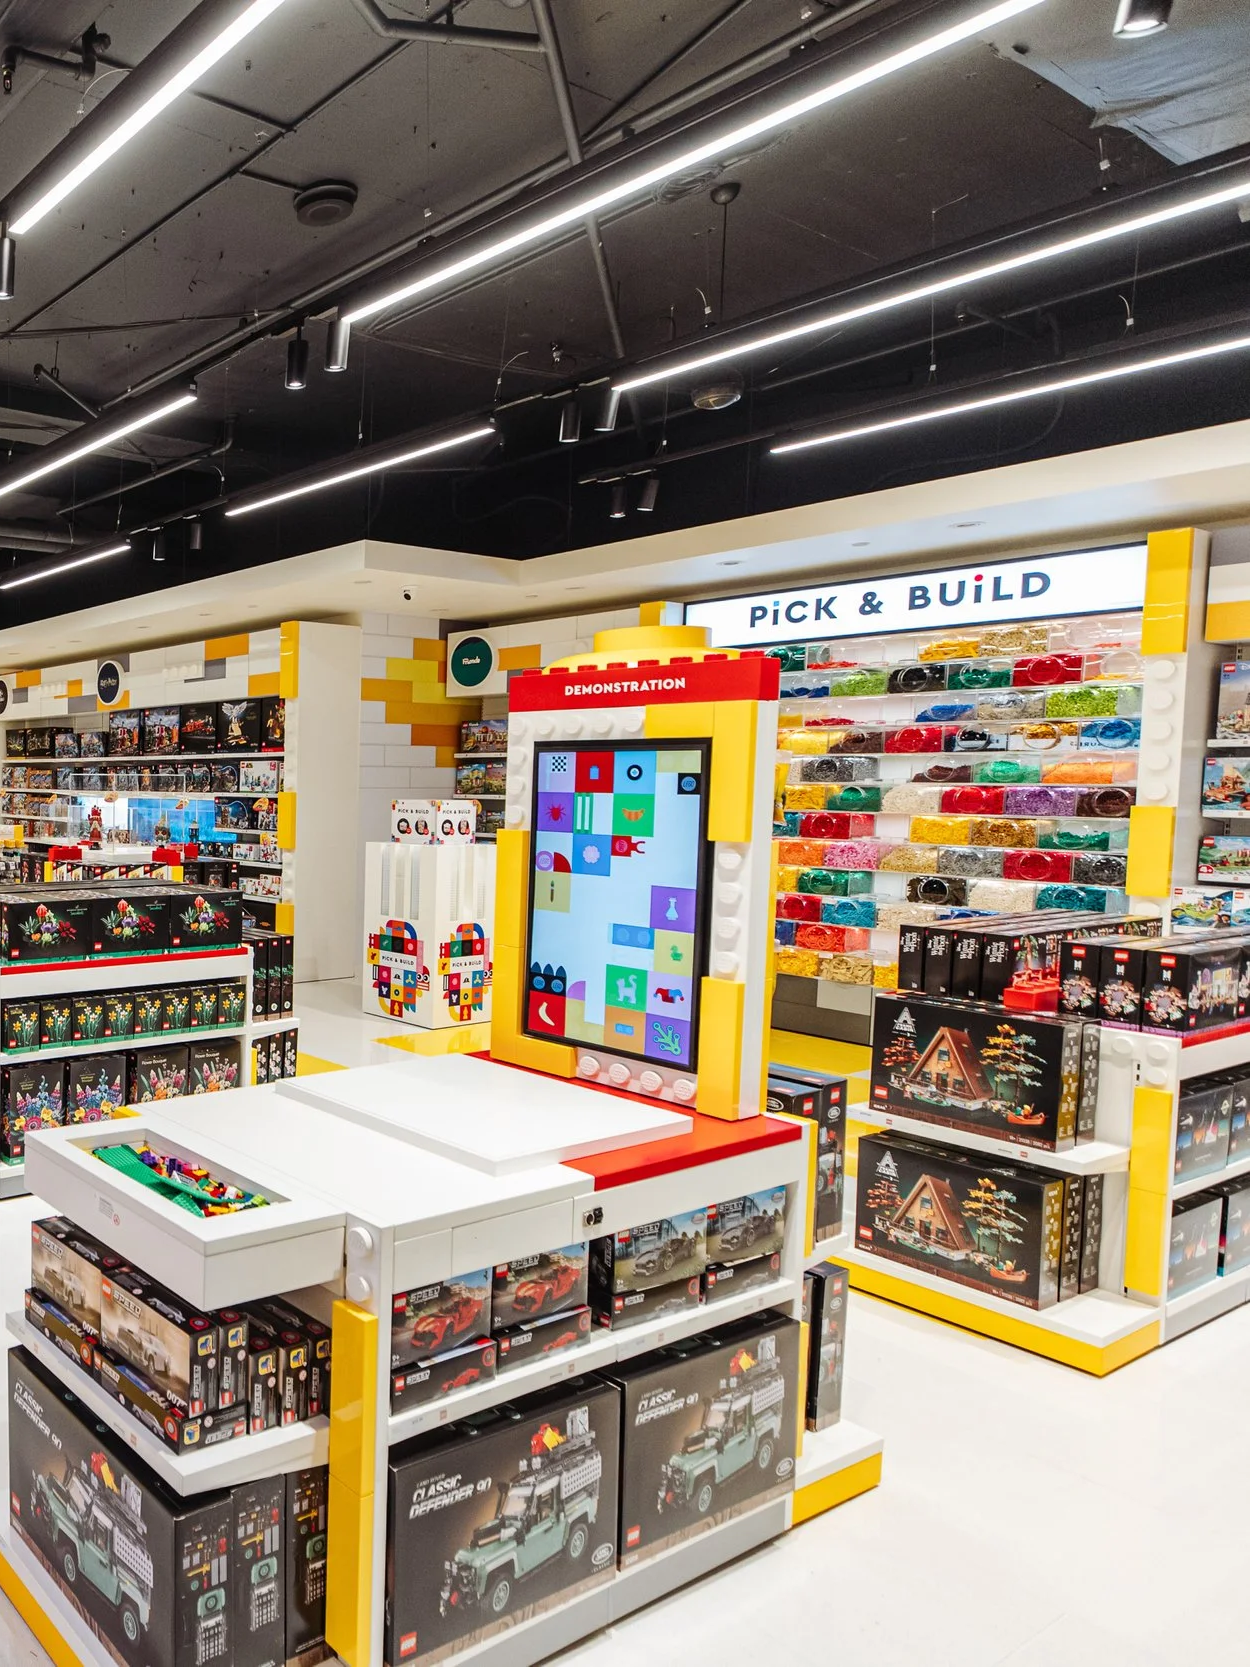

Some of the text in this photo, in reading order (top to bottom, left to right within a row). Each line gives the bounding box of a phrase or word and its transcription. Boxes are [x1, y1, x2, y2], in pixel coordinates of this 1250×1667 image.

[859, 591, 883, 616] &
[564, 677, 686, 696] DEMONSTRATION
[719, 1201, 744, 1213] SPEED
[632, 1222, 660, 1235] SPEED
[41, 1236, 64, 1256] SPEED
[511, 1255, 540, 1268] SPEED
[113, 1289, 141, 1315] SPEED
[410, 1286, 441, 1302] SPEED
[406, 1370, 430, 1384] SPEED
[15, 1382, 44, 1417] CLASSIC
[166, 1389, 188, 1407] 007
[638, 1389, 677, 1412] CLASSIC
[635, 1393, 699, 1427] DEFENDER 90
[409, 1477, 492, 1520] DEFENDER 90
[412, 1474, 462, 1503] CLASSIC
